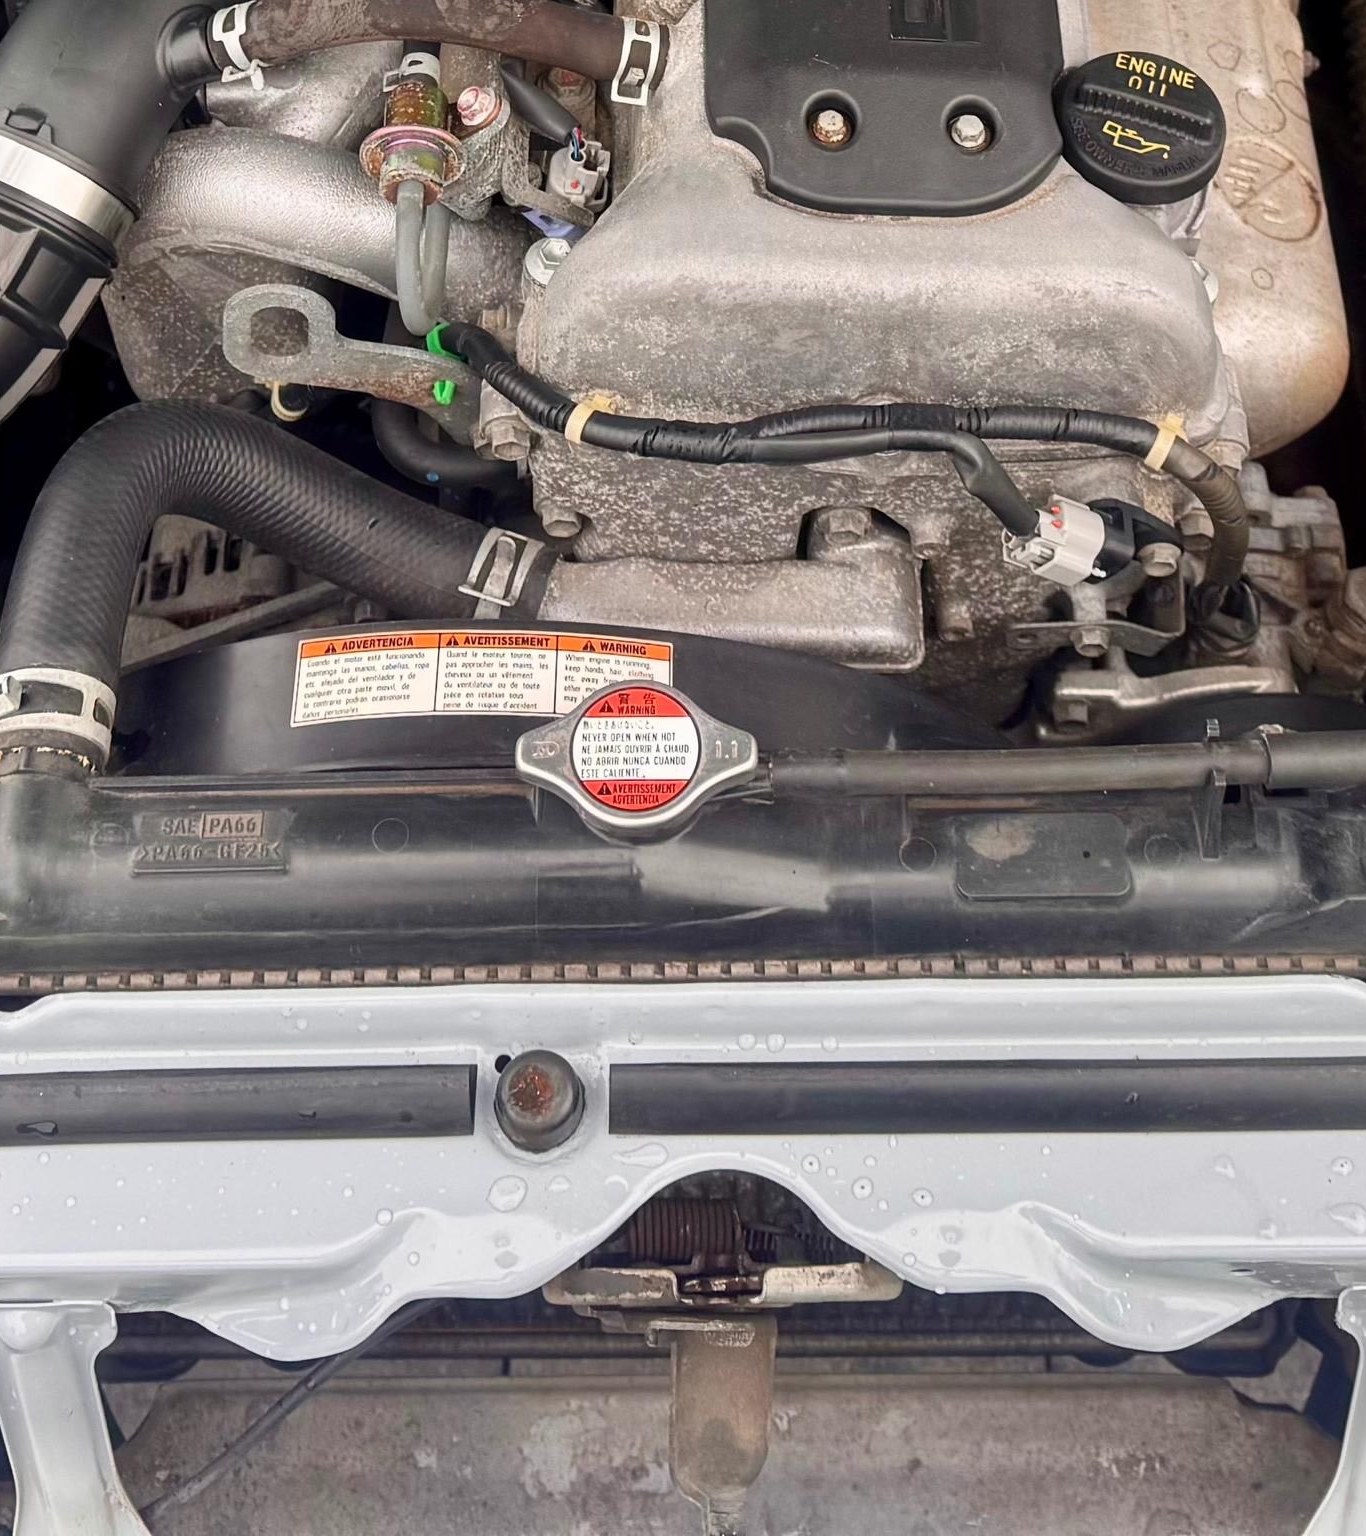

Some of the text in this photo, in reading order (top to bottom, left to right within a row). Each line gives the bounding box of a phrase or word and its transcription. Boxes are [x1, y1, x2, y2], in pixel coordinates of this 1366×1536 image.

[1115, 52, 1197, 90] ENGINE
[1151, 153, 1203, 178] MANUAL
[341, 636, 414, 651] ADVERTENCIA
[463, 635, 551, 648] AVERTISSEMENT
[599, 641, 647, 655] WARNING
[617, 705, 657, 715] WARNING
[582, 732, 676, 742] NEVER OPEN WHEN HOT
[581, 744, 591, 754] NE
[594, 744, 622, 754] JAMAIS
[624, 744, 652, 754] OUVRIR
[581, 756, 687, 766] NO ABRIR NUNCA CUANDO
[581, 768, 600, 778] ESTE
[612, 783, 677, 794] AVERTISSEMENT
[612, 794, 660, 805] ADVERTENCIA
[162, 817, 257, 835] SAE PA66
